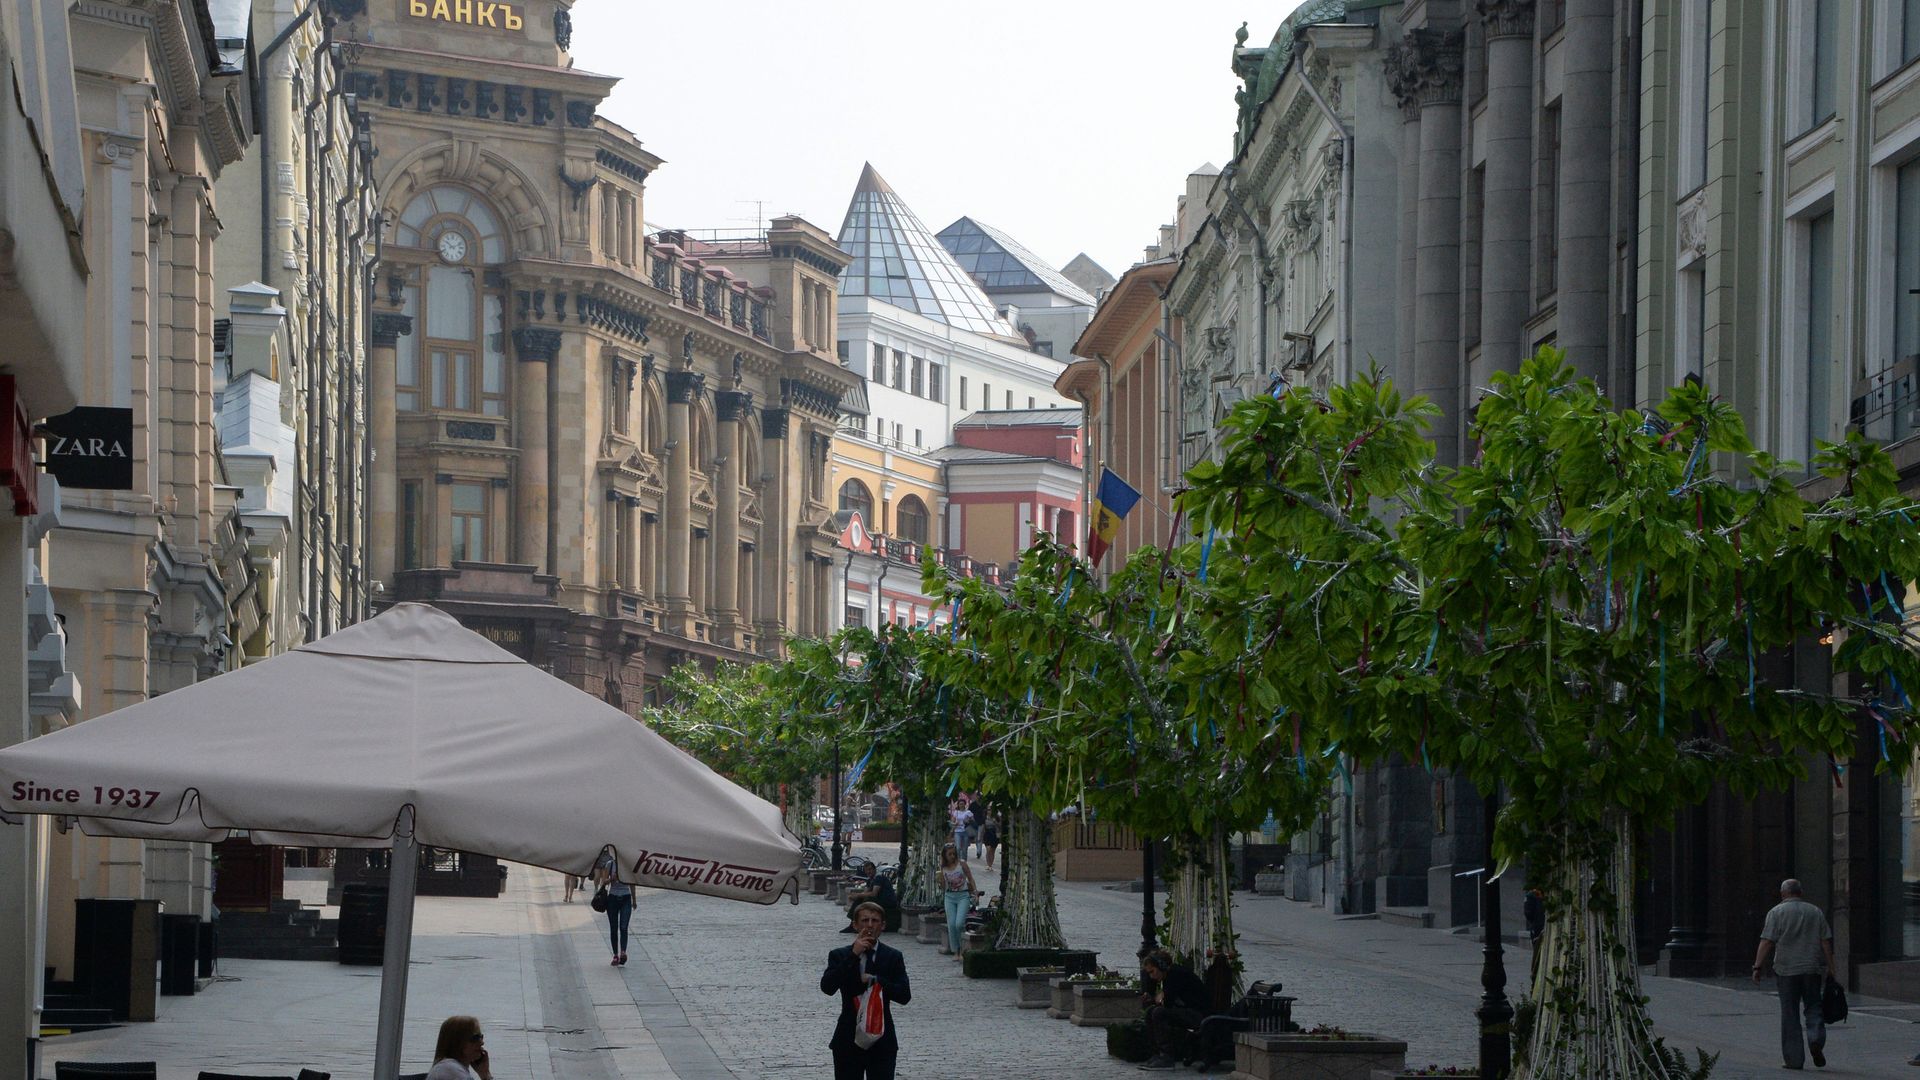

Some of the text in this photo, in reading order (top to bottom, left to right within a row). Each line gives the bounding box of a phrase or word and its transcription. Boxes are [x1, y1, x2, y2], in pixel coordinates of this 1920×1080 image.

[410, 0, 523, 31] БАНКЪ
[51, 437, 127, 458] ZARA
[12, 781, 161, 809] Since 1937
[633, 850, 780, 892] Krispy Kreme
